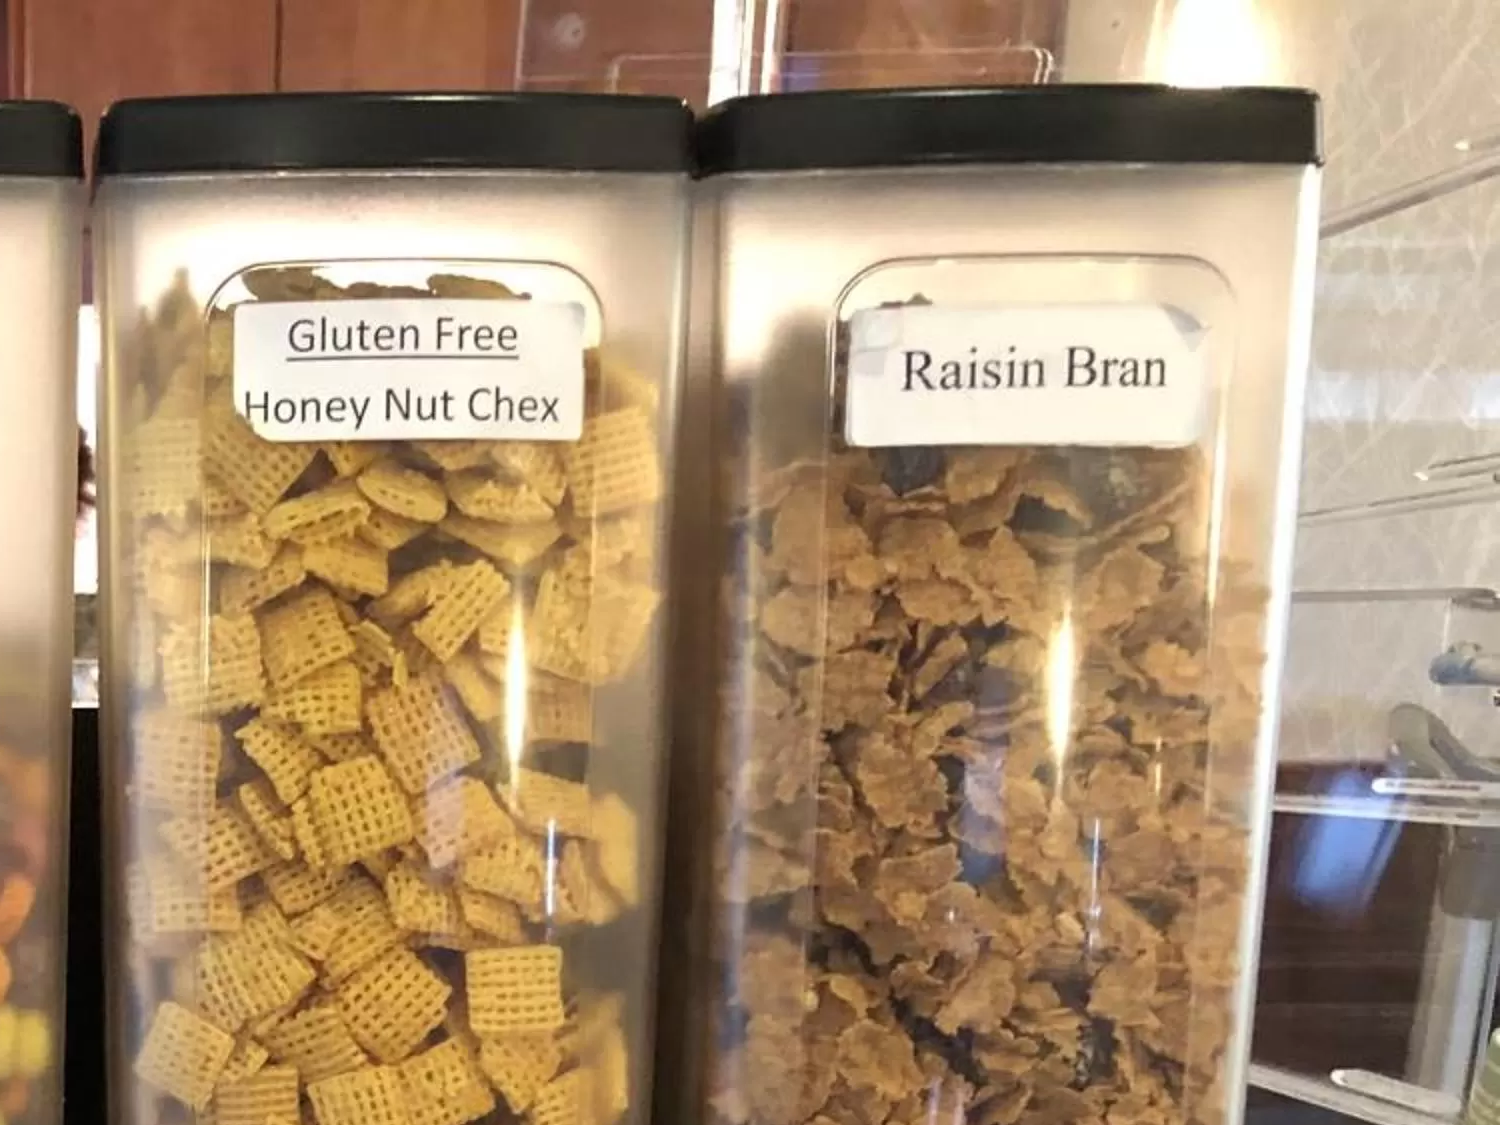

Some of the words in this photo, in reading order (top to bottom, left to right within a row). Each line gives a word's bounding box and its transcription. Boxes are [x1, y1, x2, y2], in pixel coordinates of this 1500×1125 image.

[288, 316, 420, 353] Gluten
[436, 317, 518, 351] Free
[903, 346, 1045, 391] Raisin
[1066, 346, 1165, 387] Bran
[242, 391, 371, 431] Honey
[385, 388, 454, 421] Nut
[468, 386, 558, 422] Chex
